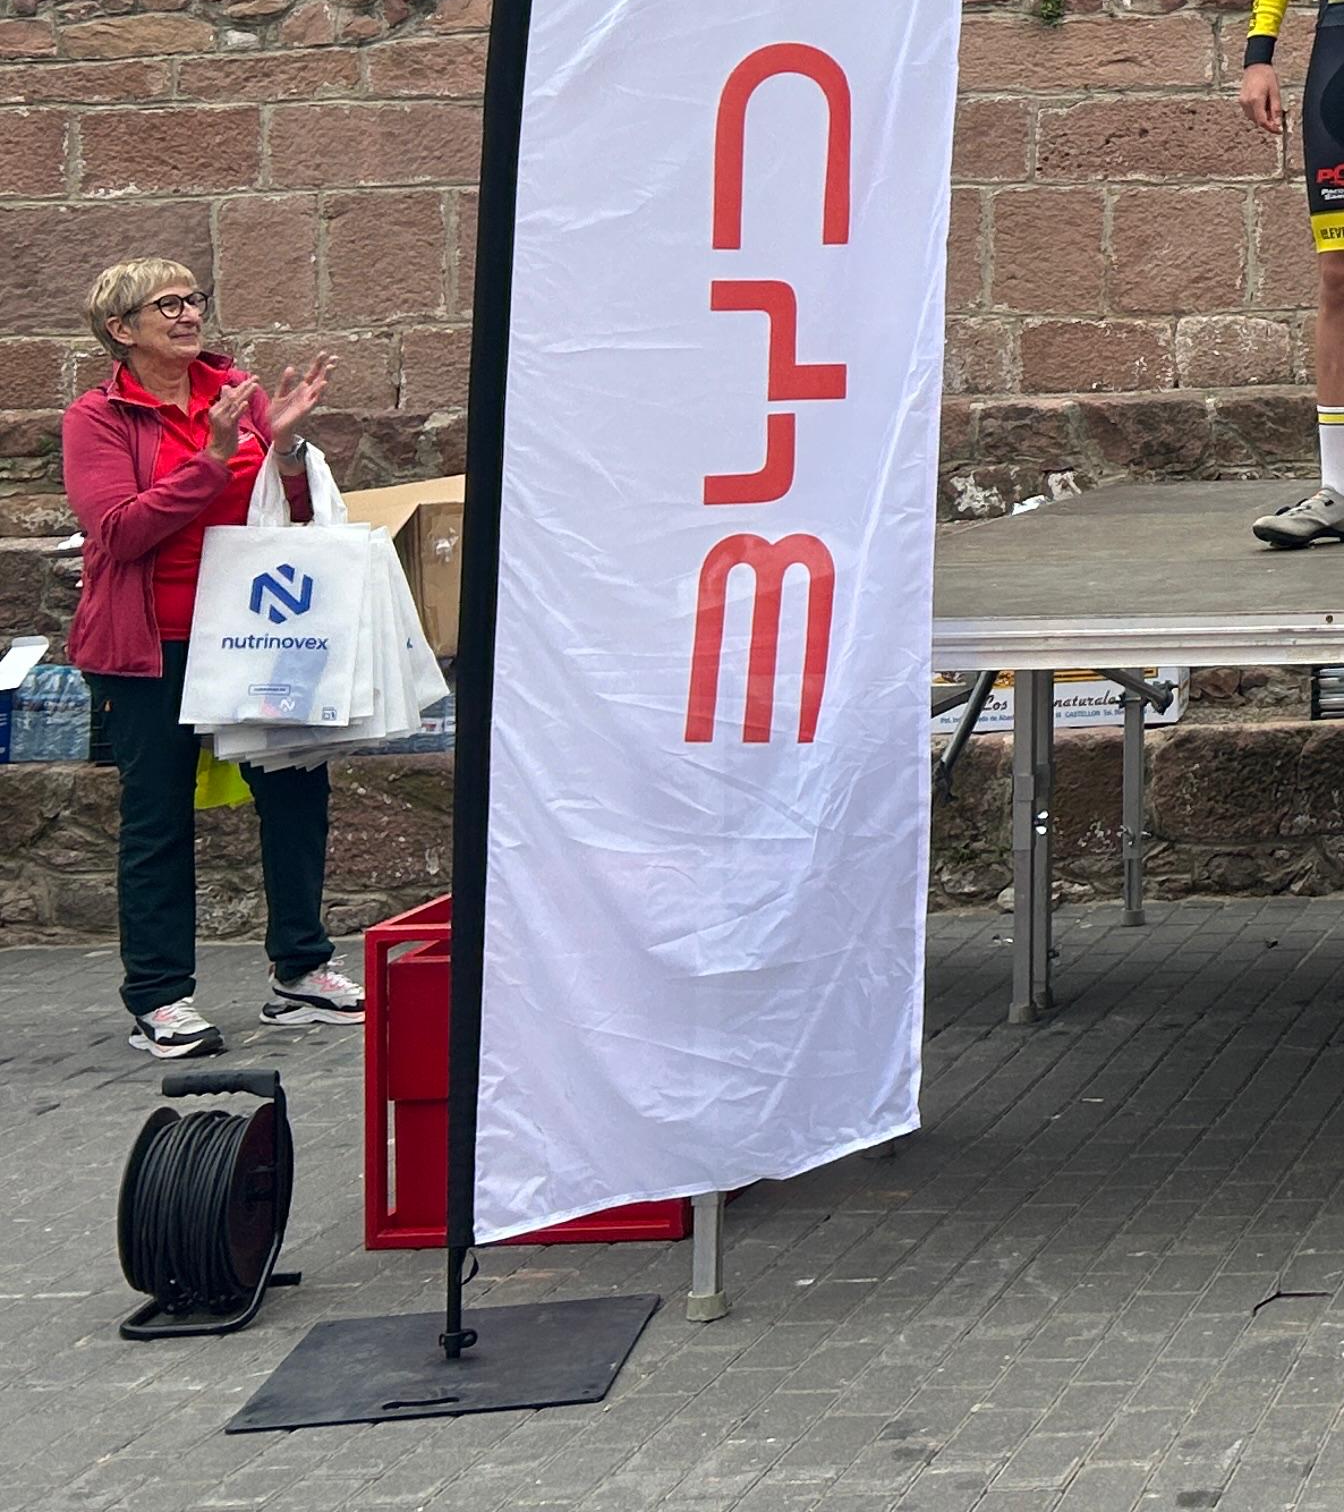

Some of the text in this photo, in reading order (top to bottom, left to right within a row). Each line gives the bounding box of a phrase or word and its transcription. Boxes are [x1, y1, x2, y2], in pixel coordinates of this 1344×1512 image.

[685, 41, 851, 744] BYD
[221, 633, 329, 650] nutrinovex
[984, 694, 1008, 711] Los
